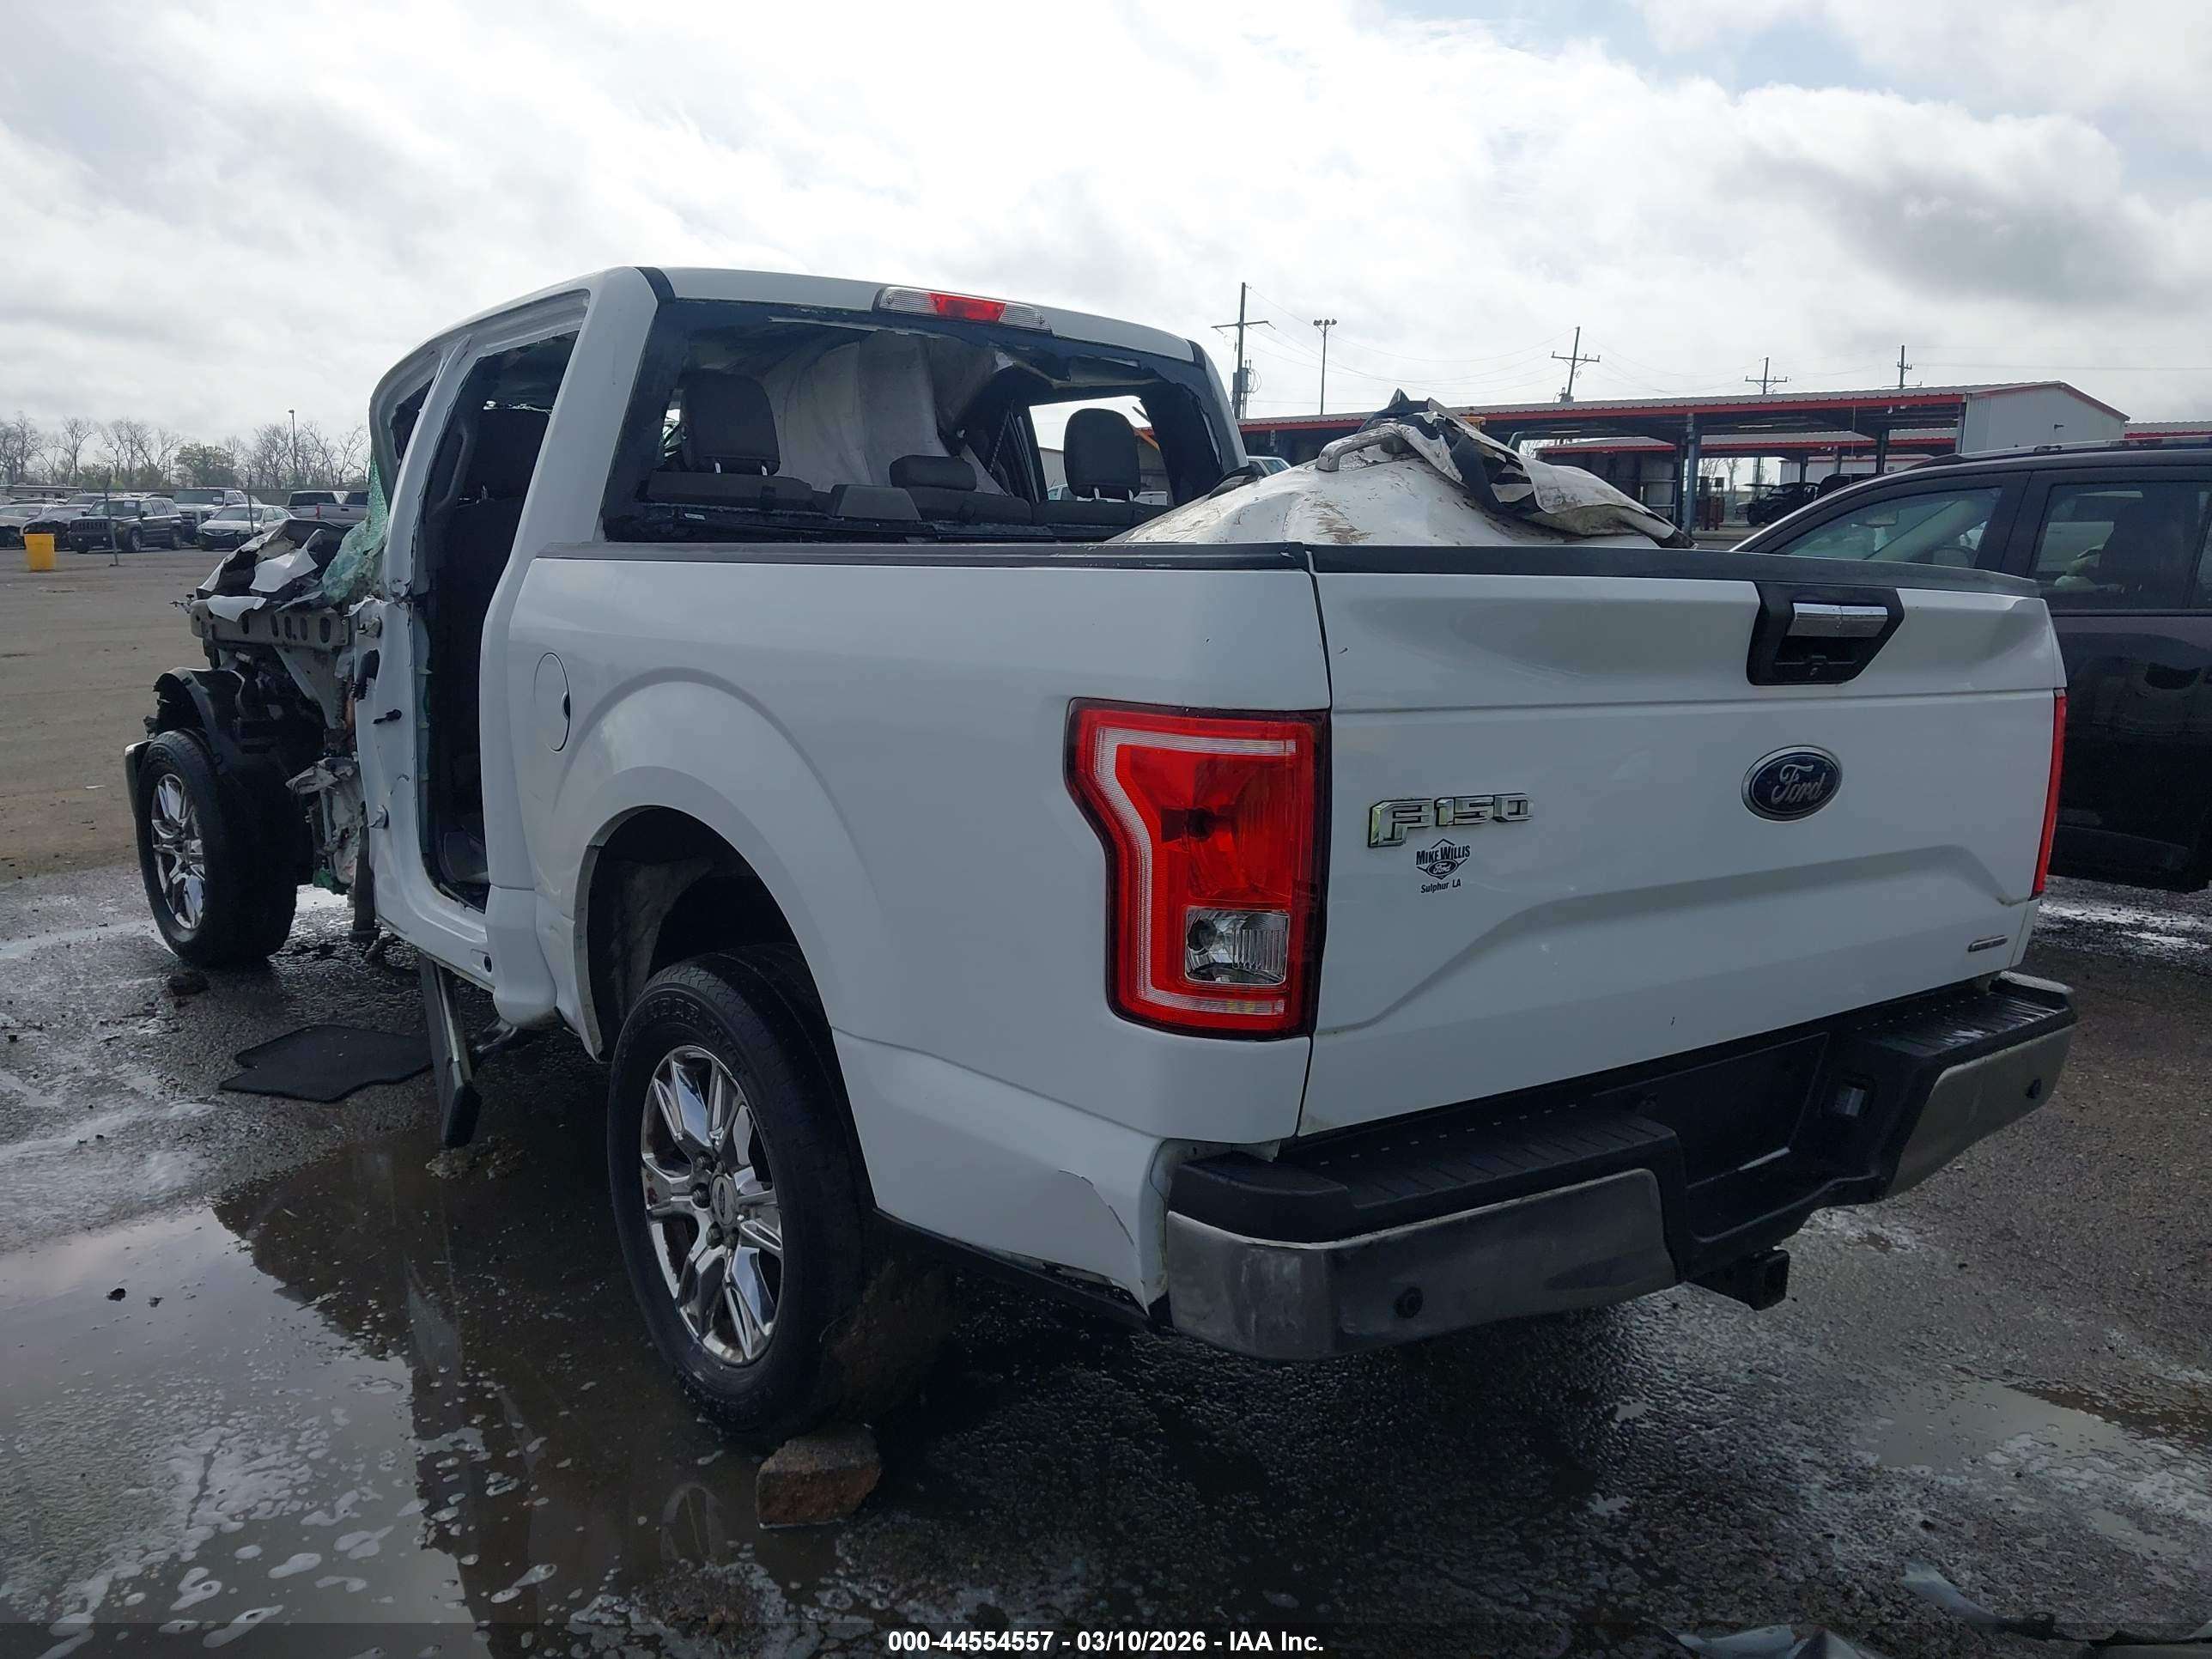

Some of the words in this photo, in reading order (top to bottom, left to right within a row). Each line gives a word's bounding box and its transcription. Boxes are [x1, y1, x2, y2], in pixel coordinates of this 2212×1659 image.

[1771, 763, 1826, 805] Ford
[1416, 849, 1439, 866] MIKE
[1440, 845, 1470, 860] WILLIS
[1421, 881, 1449, 894] Sulphur
[1452, 878, 1462, 888] LA
